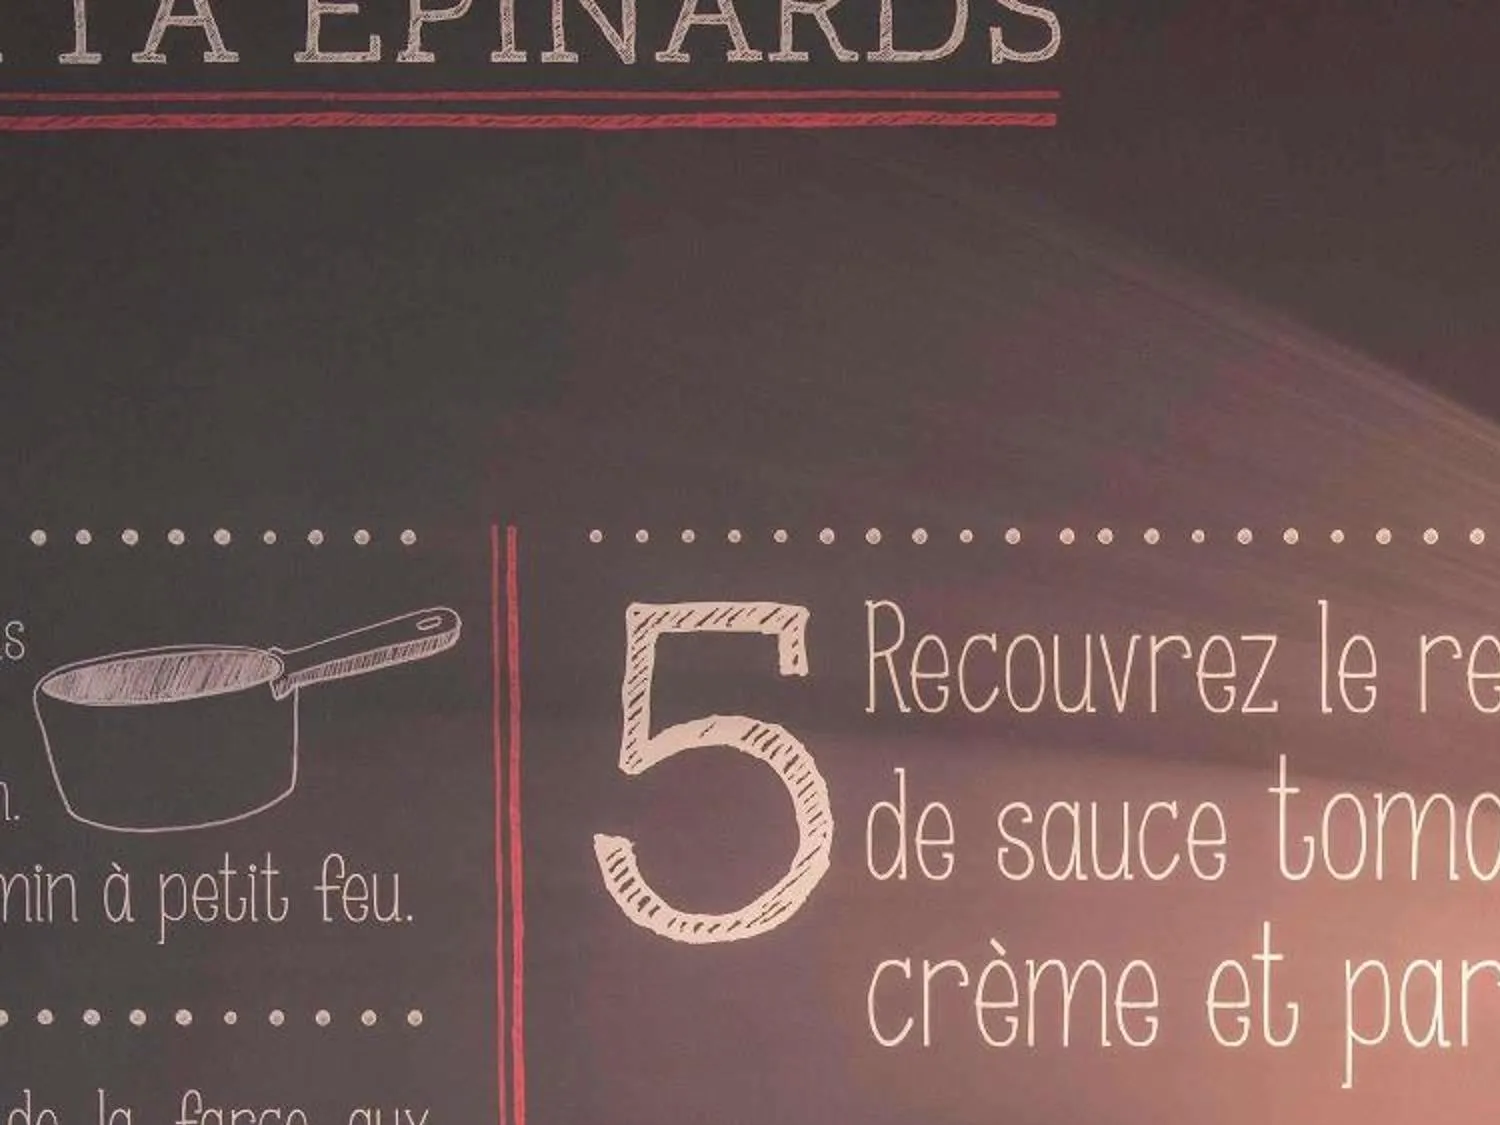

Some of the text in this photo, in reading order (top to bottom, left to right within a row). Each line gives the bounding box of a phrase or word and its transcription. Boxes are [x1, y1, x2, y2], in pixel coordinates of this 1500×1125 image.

[864, 599, 1279, 714] Recouvrez
[1317, 599, 1377, 714] le
[593, 601, 835, 945] 5
[866, 767, 955, 881] de
[997, 800, 1227, 881] sauce
[103, 861, 135, 923] à
[157, 851, 289, 945] petit
[313, 852, 413, 923] feu.
[867, 937, 1159, 1048] crème
[1205, 920, 1299, 1047] et
